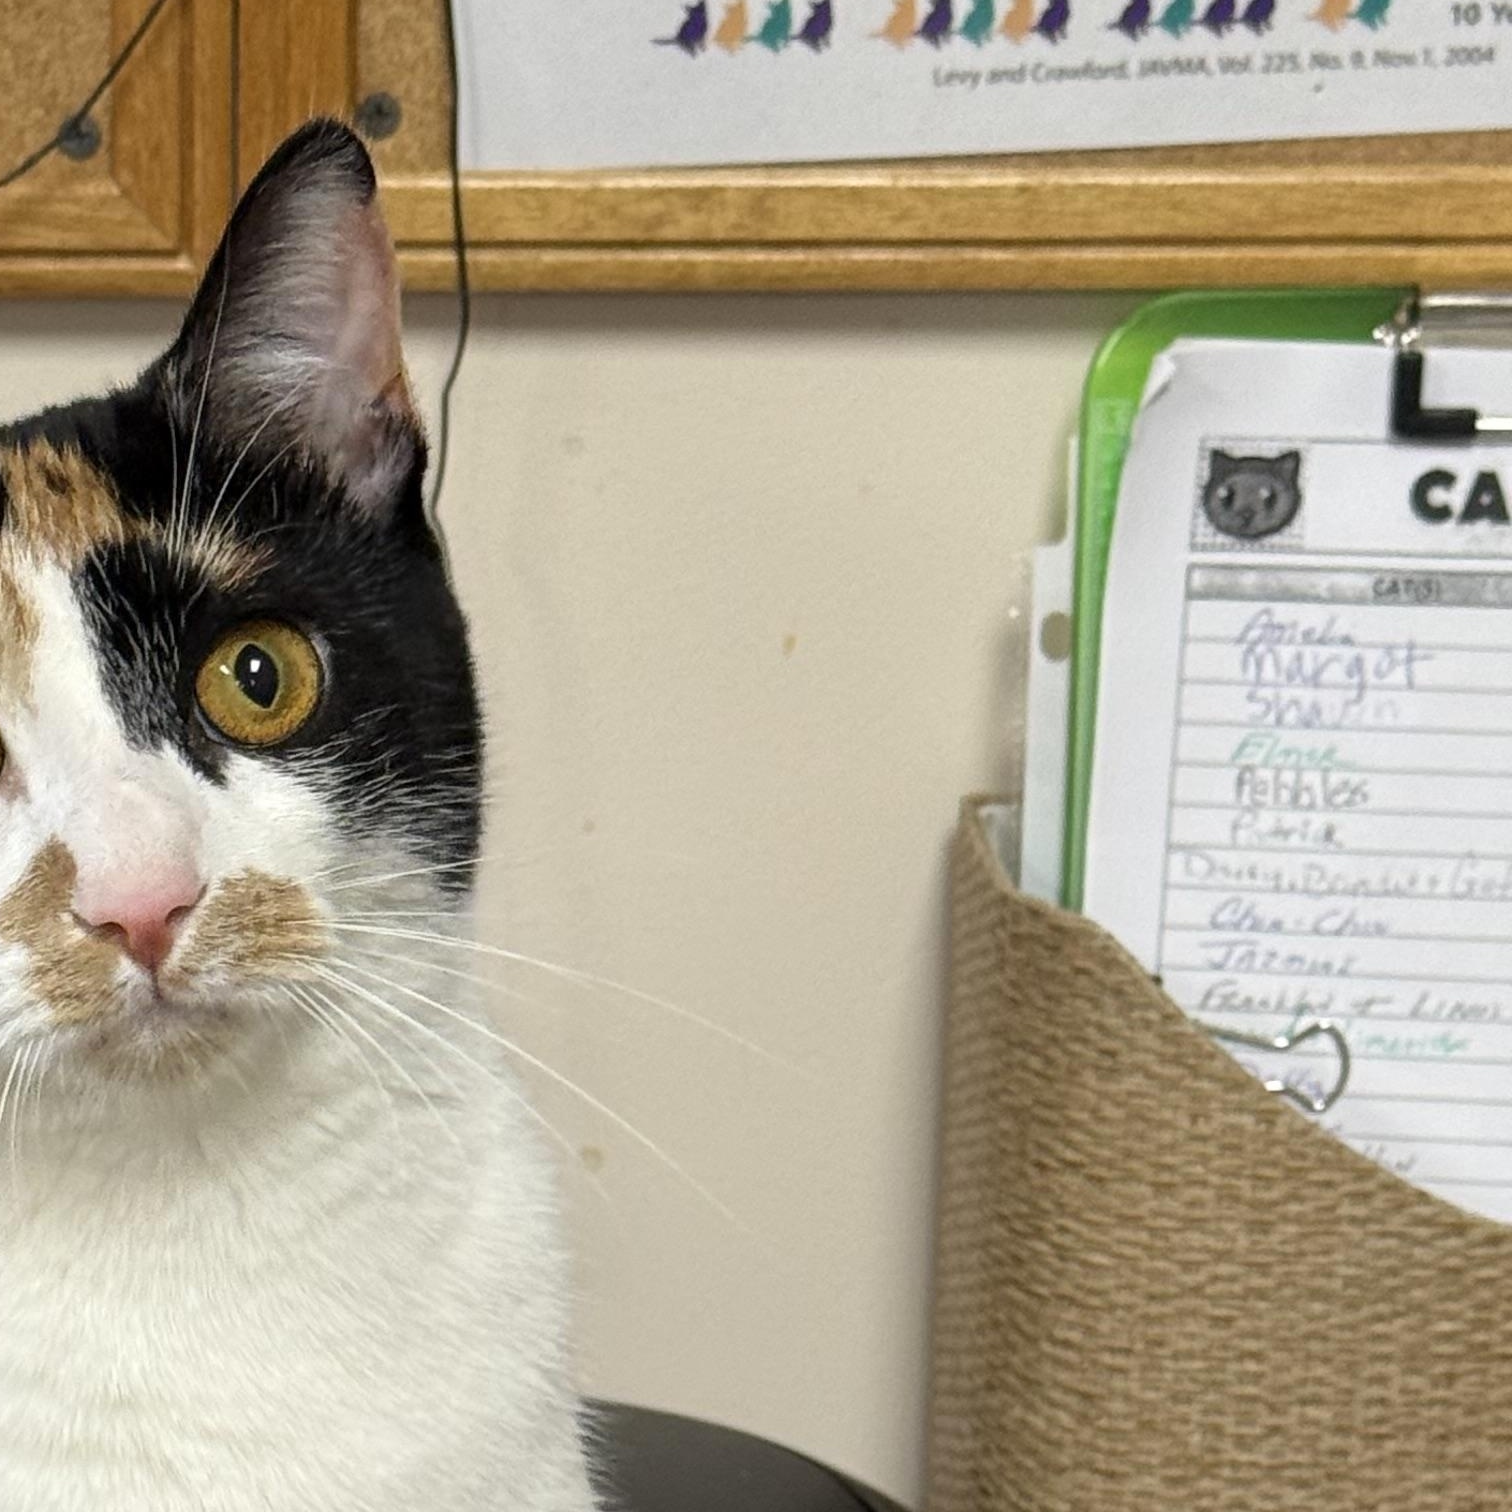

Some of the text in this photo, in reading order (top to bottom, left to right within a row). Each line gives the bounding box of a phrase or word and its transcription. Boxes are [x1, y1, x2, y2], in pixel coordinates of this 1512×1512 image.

[1451, 2, 1483, 26] 10
[933, 65, 982, 89] Levy
[985, 63, 1027, 85] and
[1444, 46, 1496, 68] 2004
[1241, 638, 1435, 705] Margot
[1235, 763, 1370, 812] Pebbles
